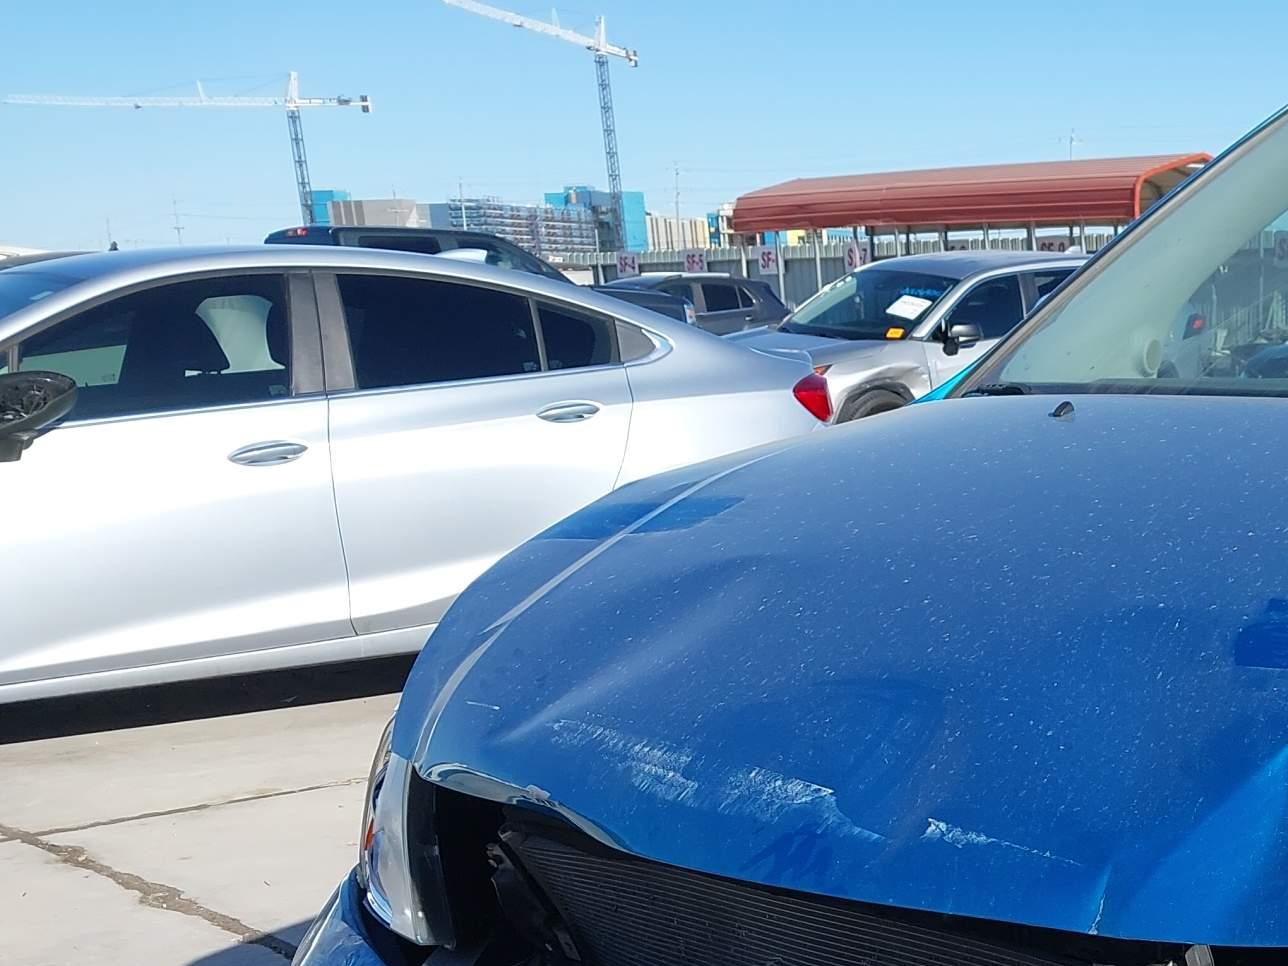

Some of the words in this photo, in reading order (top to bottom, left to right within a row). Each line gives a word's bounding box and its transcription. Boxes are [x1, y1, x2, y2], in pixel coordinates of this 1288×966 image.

[618, 256, 636, 273] SF-4
[686, 254, 704, 271] SF-5
[761, 251, 776, 270] SF-
[847, 247, 868, 267] S-7
